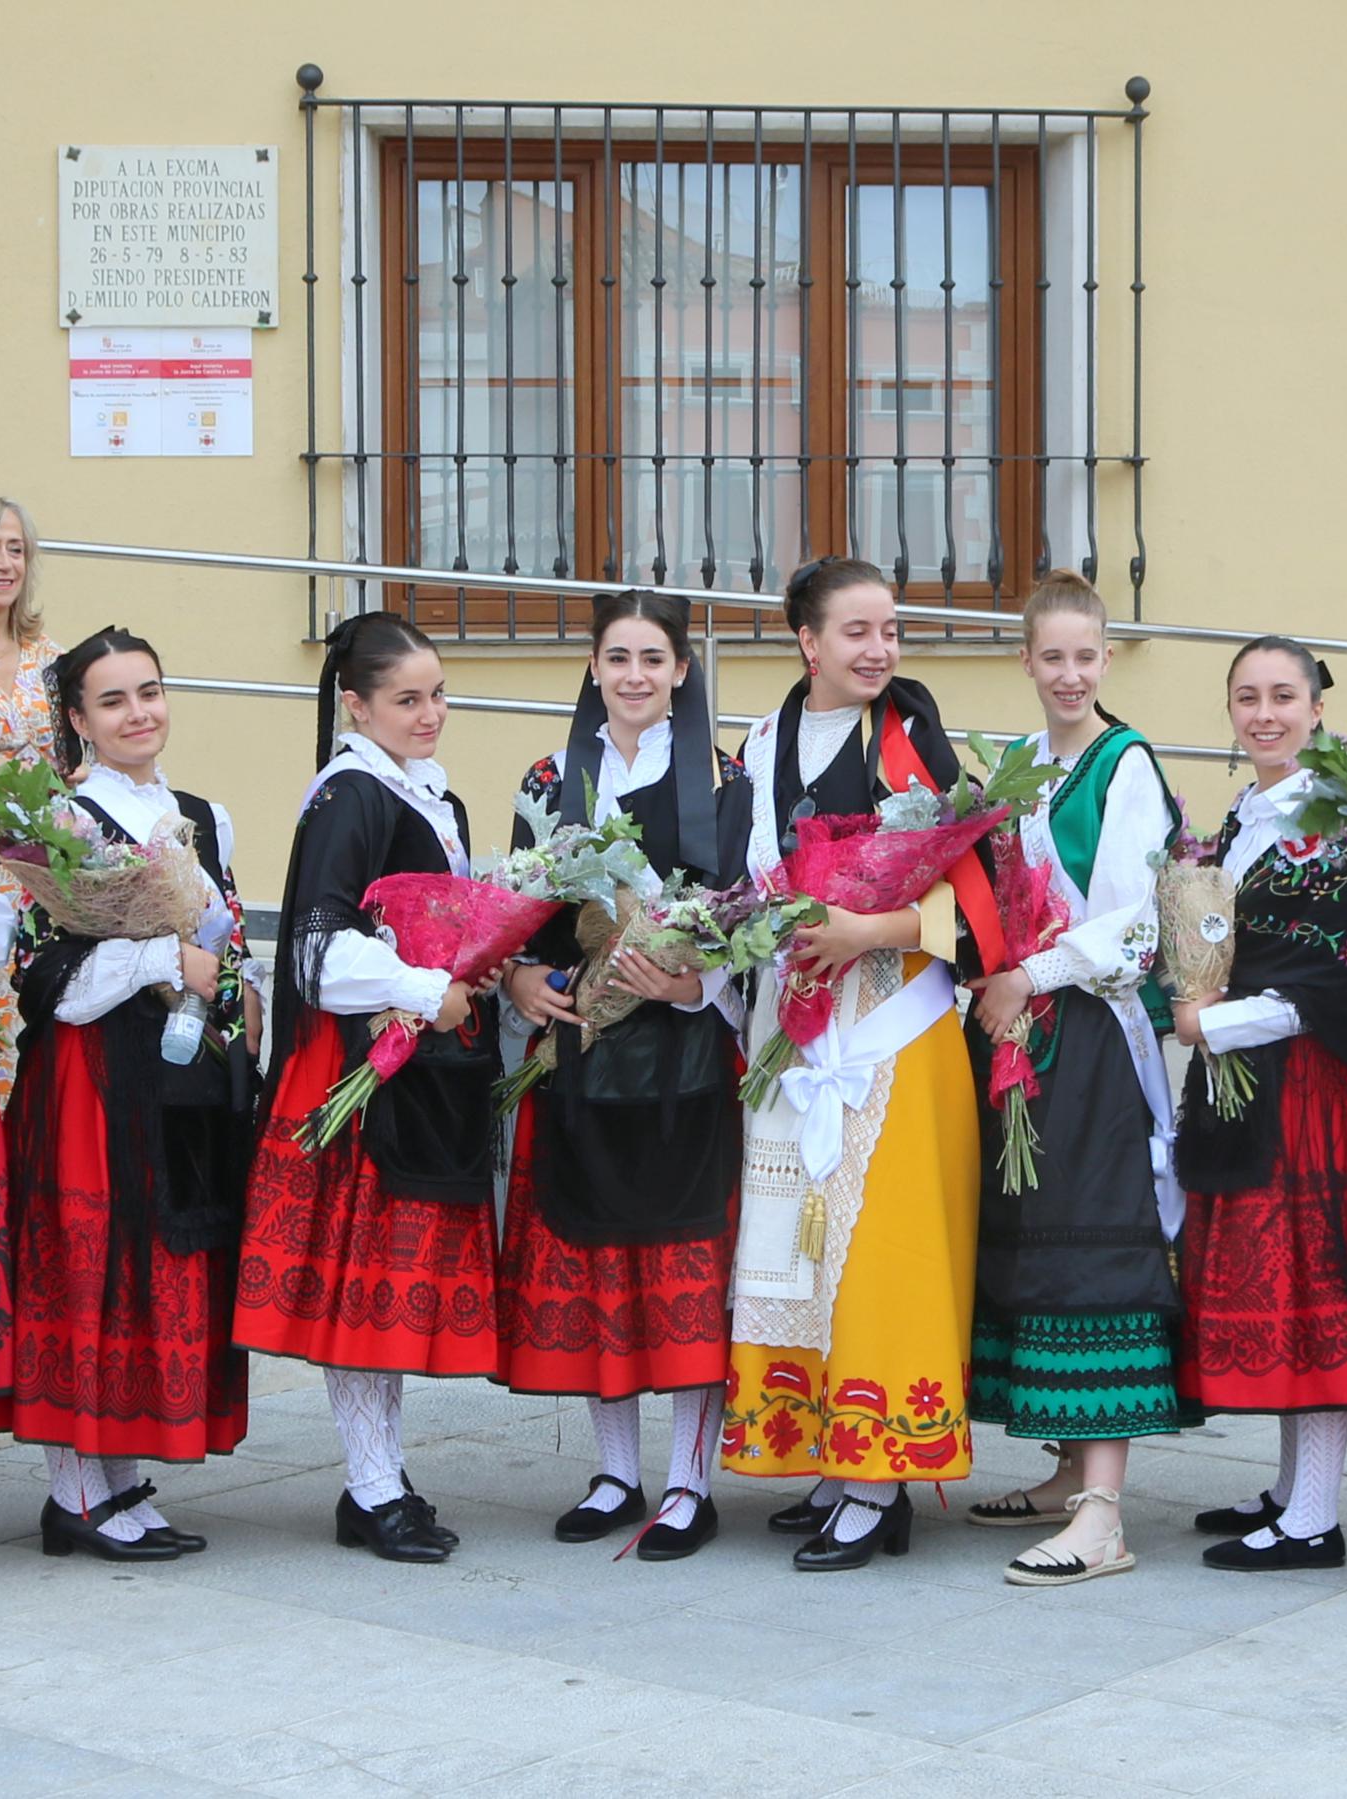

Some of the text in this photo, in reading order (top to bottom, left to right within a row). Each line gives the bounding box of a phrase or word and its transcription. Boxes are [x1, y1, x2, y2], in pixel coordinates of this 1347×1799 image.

[117, 159, 220, 177] A LA EXCMA
[73, 181, 264, 199] DIPUTACION PROVINCIAL
[72, 202, 265, 220] POR OBRAS REALIZADAS
[93, 225, 246, 242] EN ESTE MUNICIPIO
[92, 269, 246, 286] SIENDO PRESIDENTE
[146, 291, 184, 309] POLO
[192, 291, 270, 309] CALDERON
